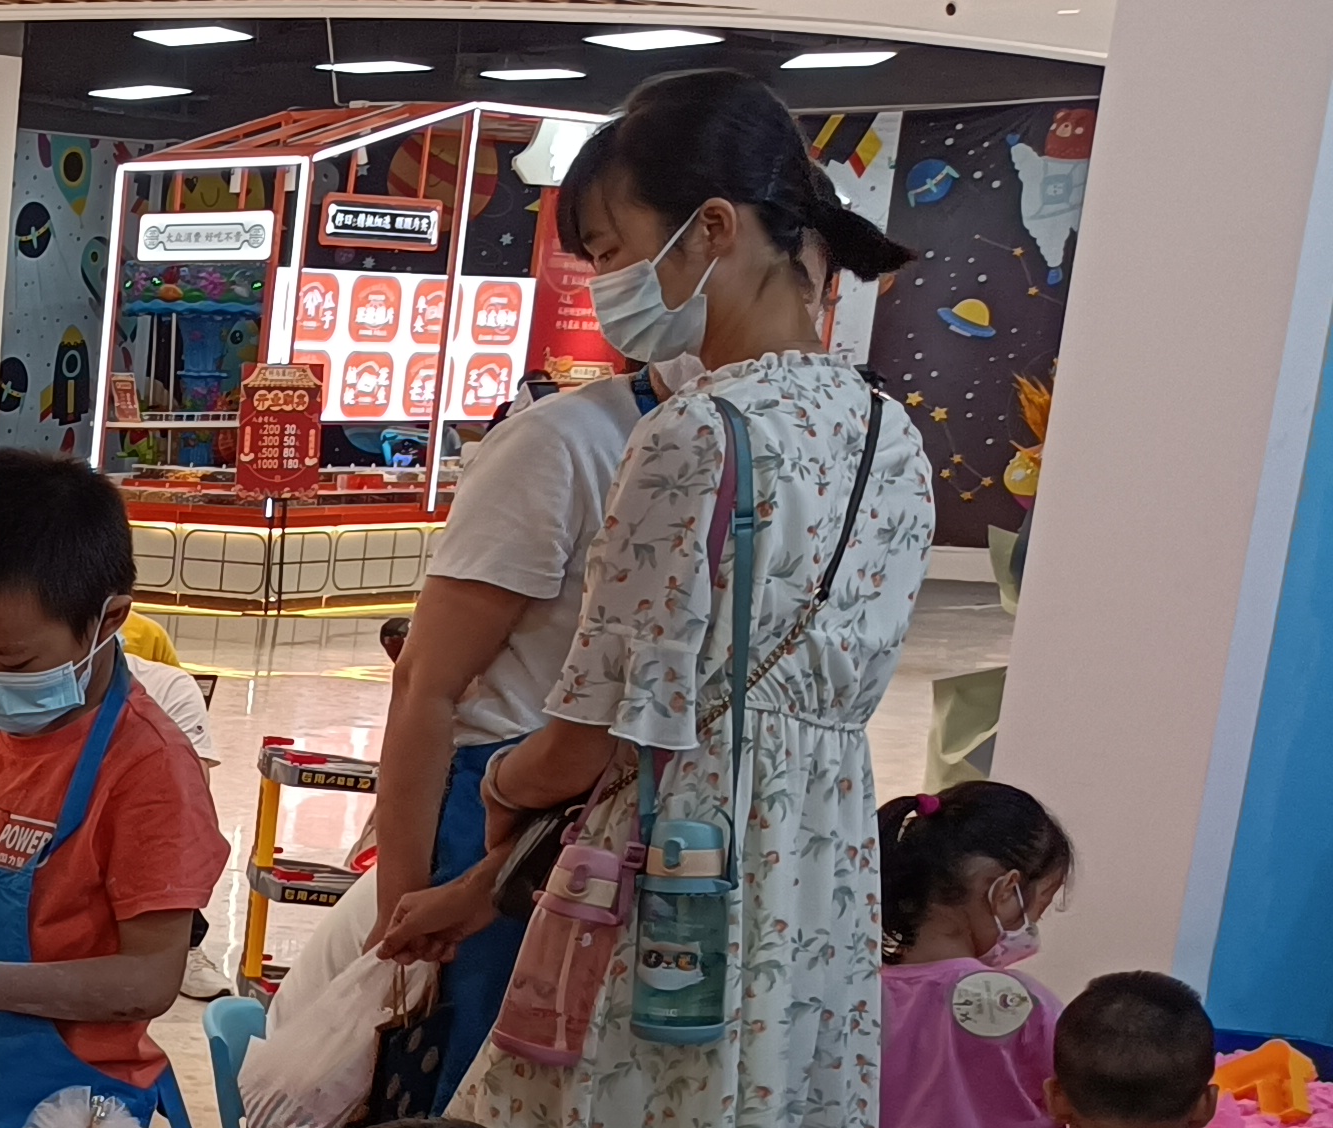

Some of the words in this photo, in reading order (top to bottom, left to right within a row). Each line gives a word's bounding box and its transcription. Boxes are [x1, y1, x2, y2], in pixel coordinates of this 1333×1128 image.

[166, 231, 201, 243] 大众消费
[205, 231, 242, 243] 好吃不贵
